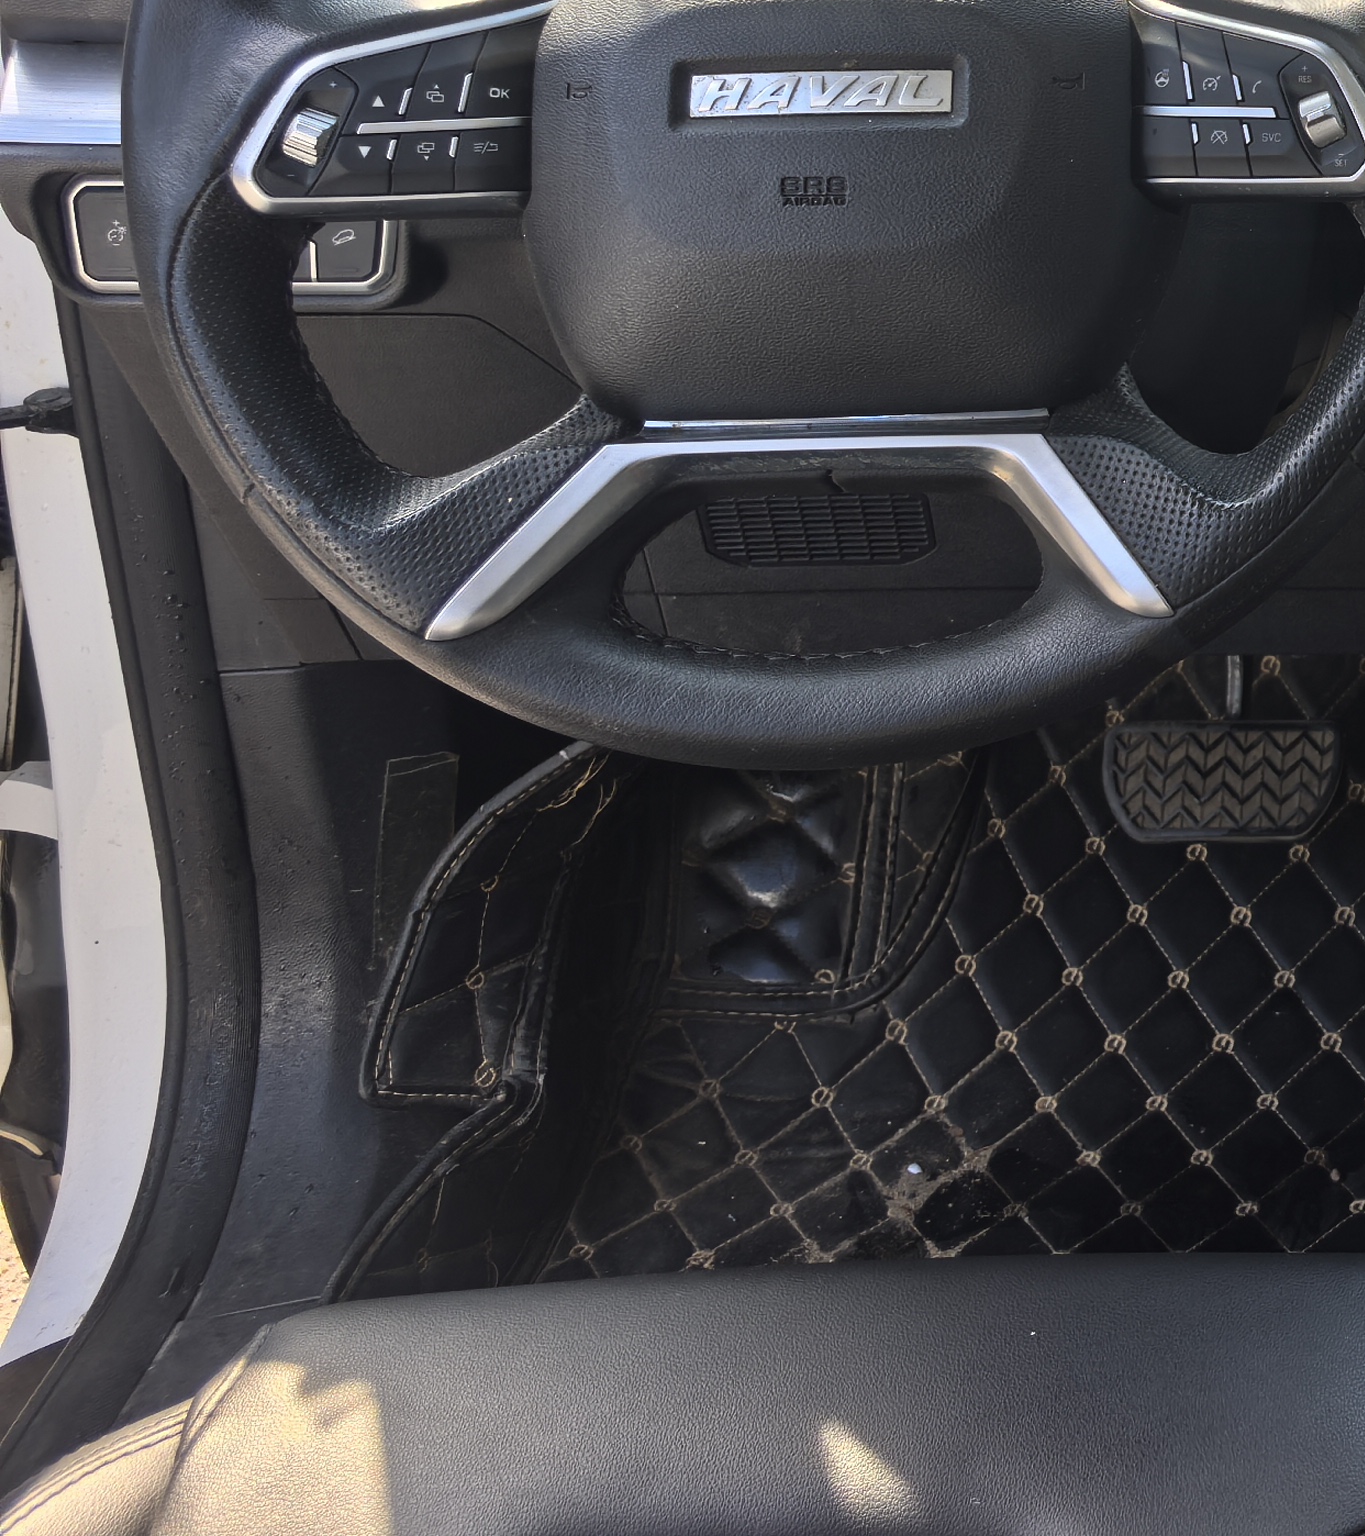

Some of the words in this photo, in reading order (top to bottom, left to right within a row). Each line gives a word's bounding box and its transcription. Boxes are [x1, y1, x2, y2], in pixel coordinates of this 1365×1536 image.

[1298, 75, 1312, 83] RES
[489, 87, 511, 99] OK
[697, 75, 945, 112] HAVAL
[1261, 132, 1282, 142] SVC
[780, 175, 849, 196] SRS
